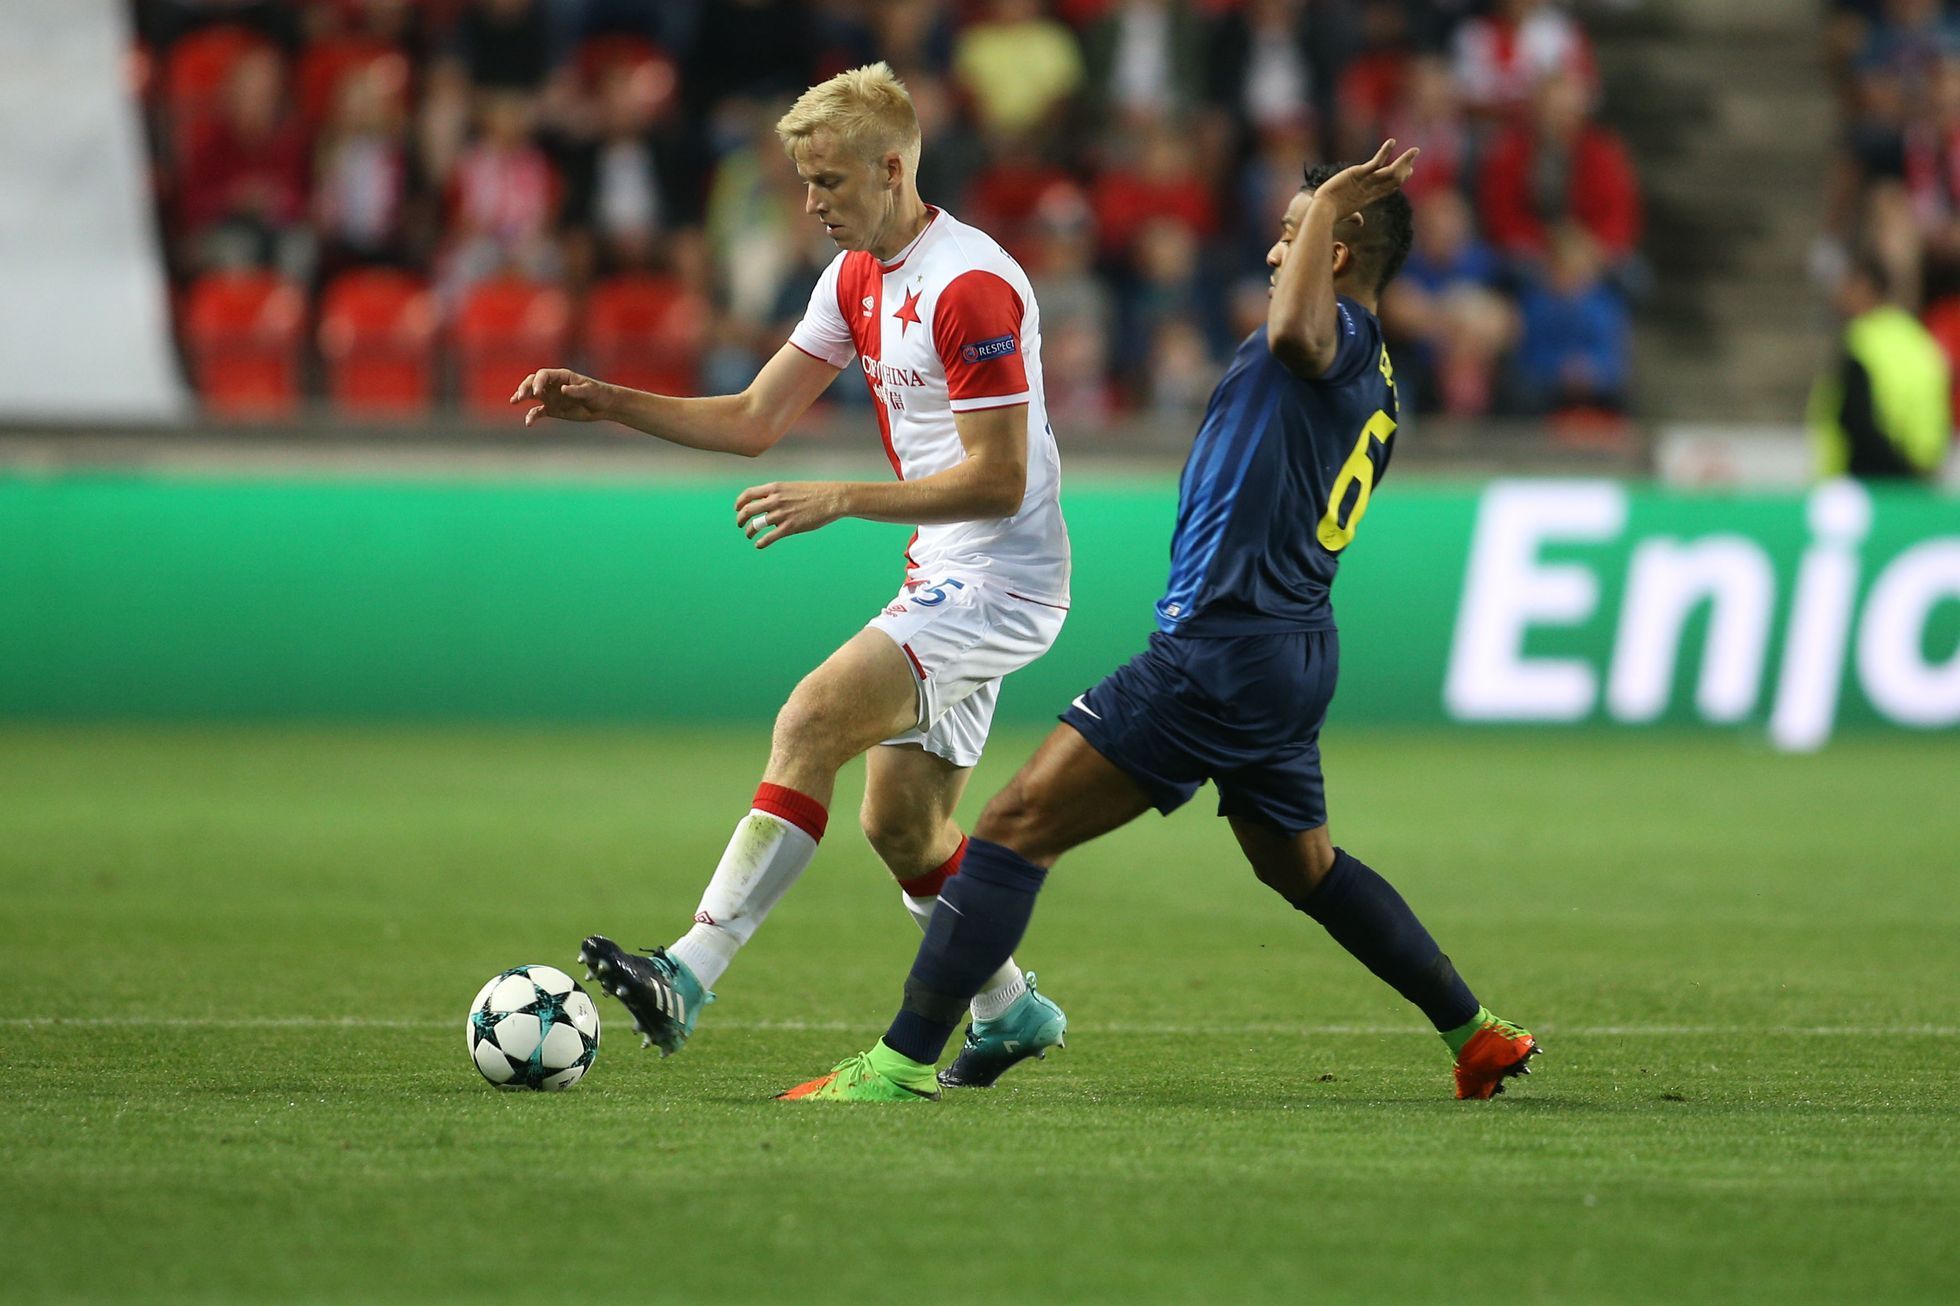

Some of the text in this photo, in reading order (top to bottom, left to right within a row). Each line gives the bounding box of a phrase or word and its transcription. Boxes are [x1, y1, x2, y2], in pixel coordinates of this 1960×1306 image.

[979, 339, 1015, 357] RESPECT
[1316, 409, 1398, 552] 6
[1445, 479, 1960, 753] Enjo
